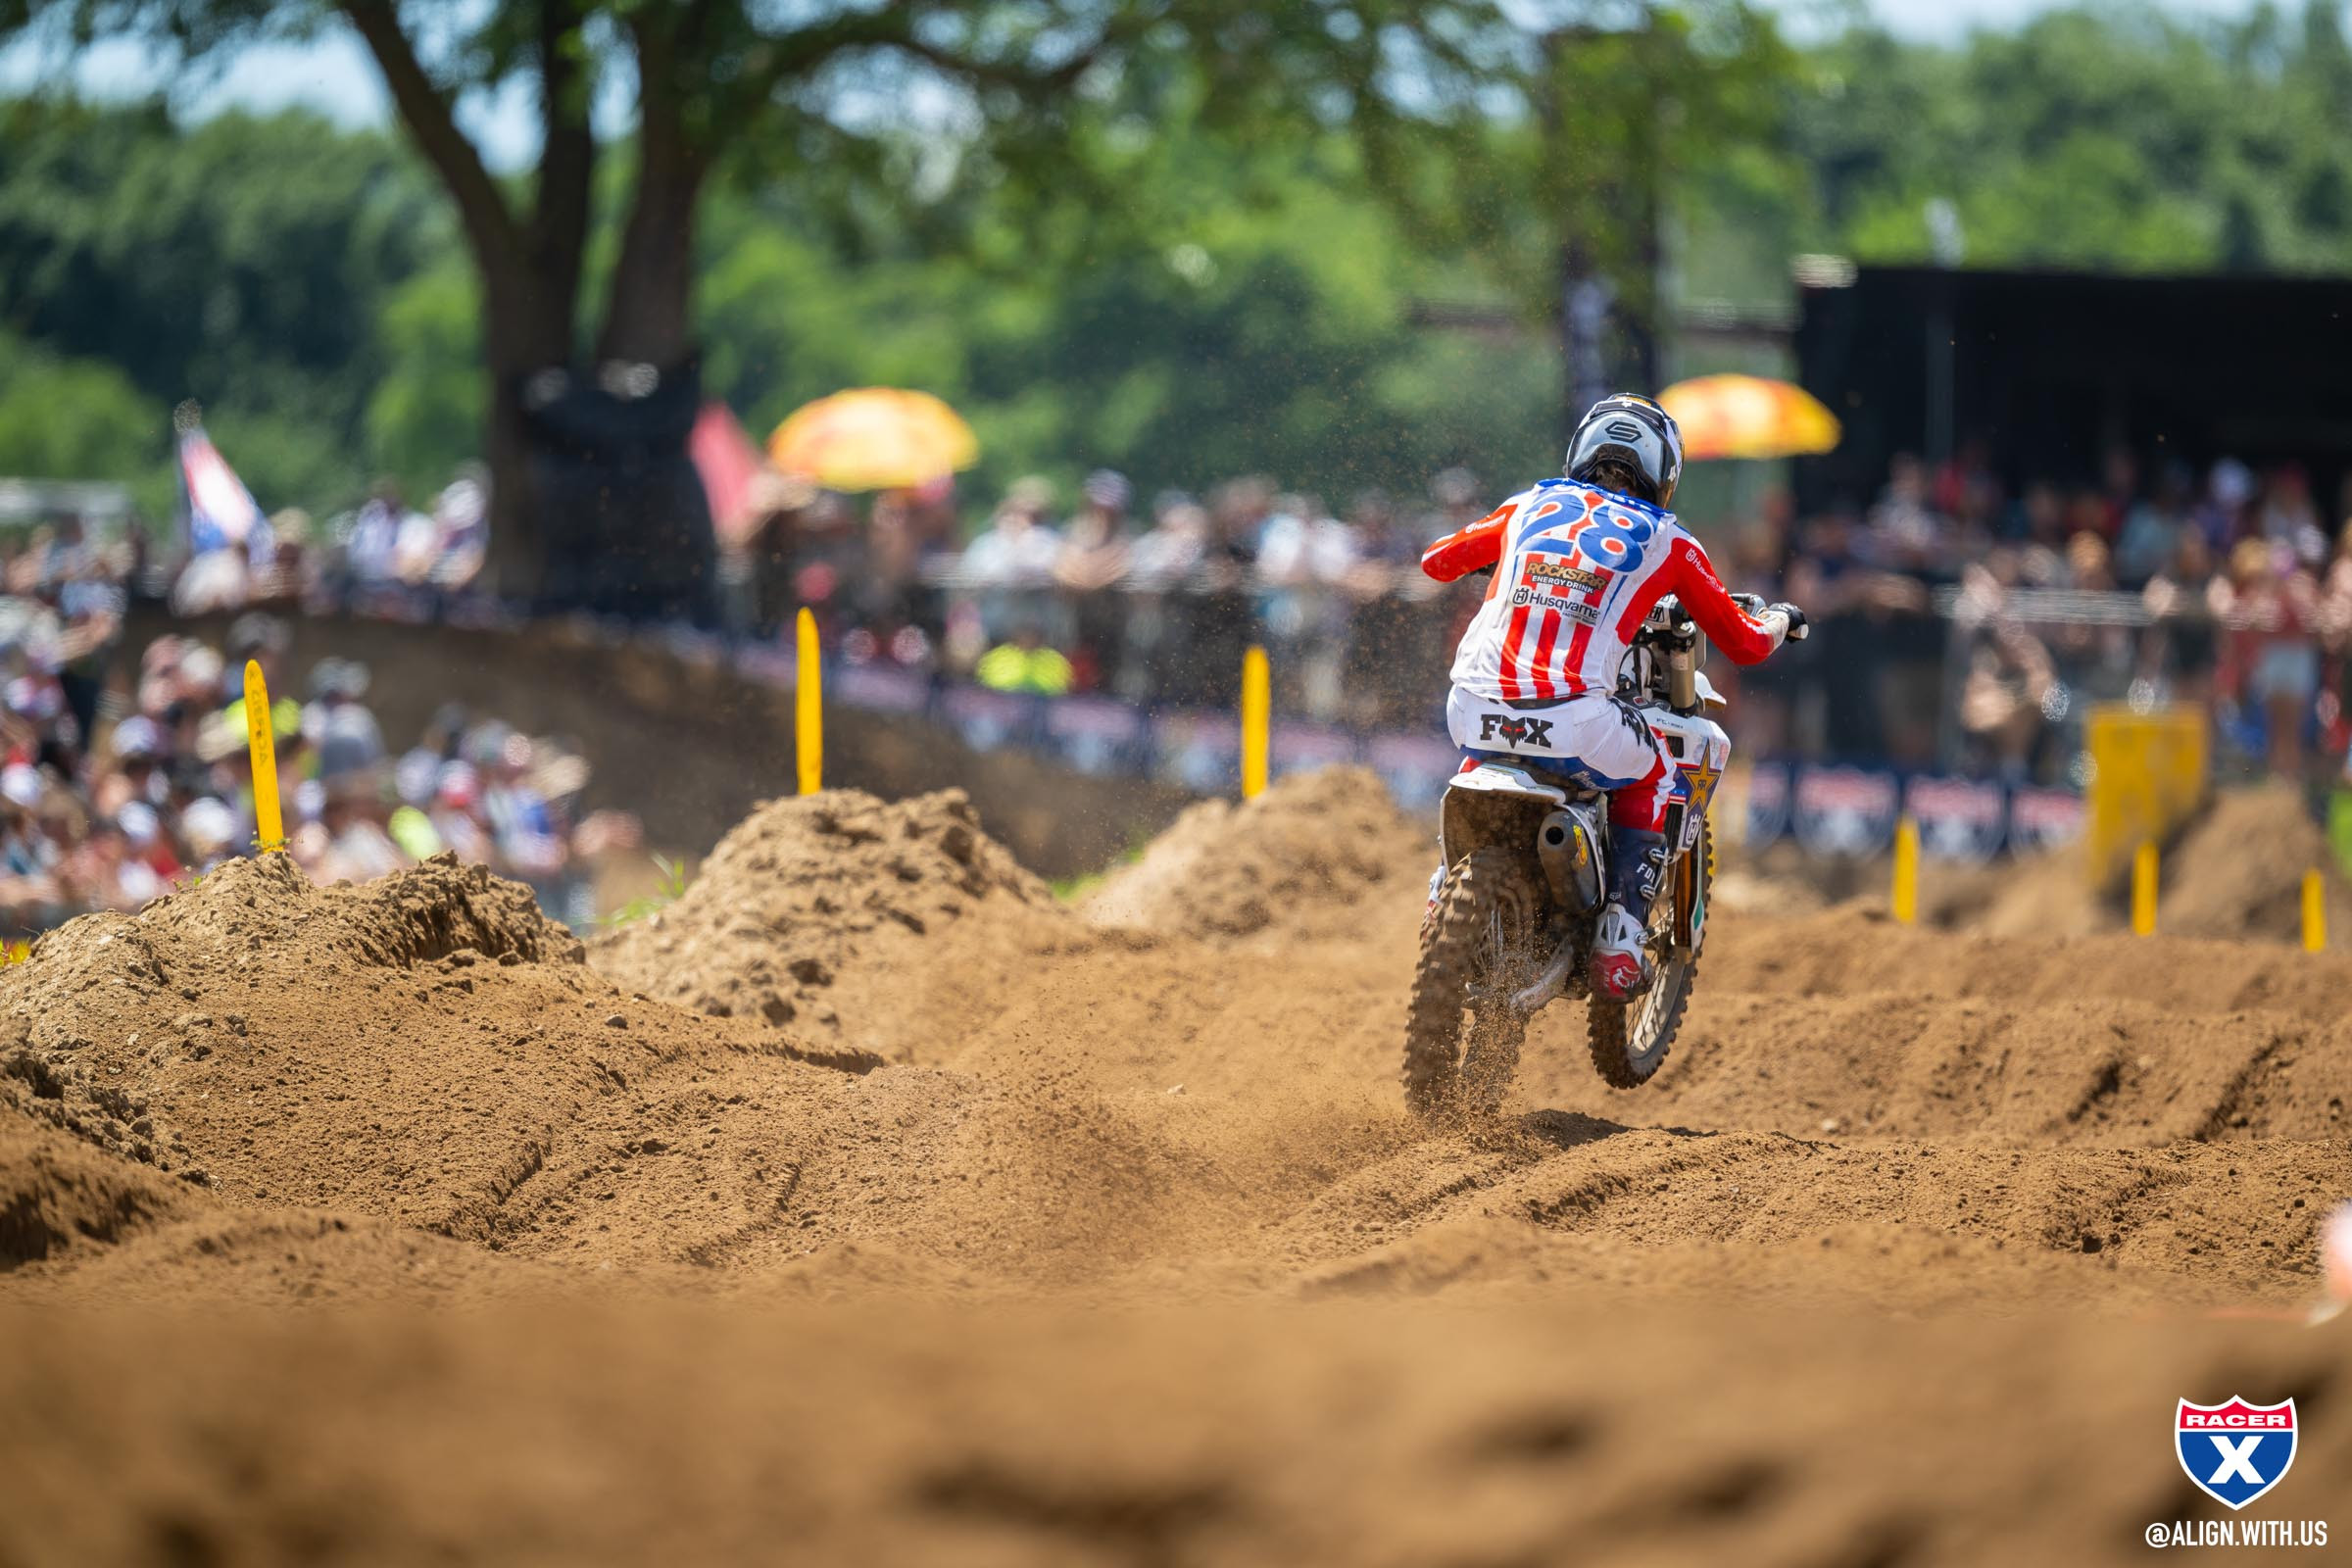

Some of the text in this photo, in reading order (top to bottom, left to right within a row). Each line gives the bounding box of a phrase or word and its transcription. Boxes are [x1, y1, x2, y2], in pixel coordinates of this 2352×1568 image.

[1515, 493, 1654, 573] 28
[1525, 563, 1607, 589] ROCKSTAR
[1532, 575, 1594, 594] ENERGY DRINK
[1529, 592, 1599, 619] Husqvarna
